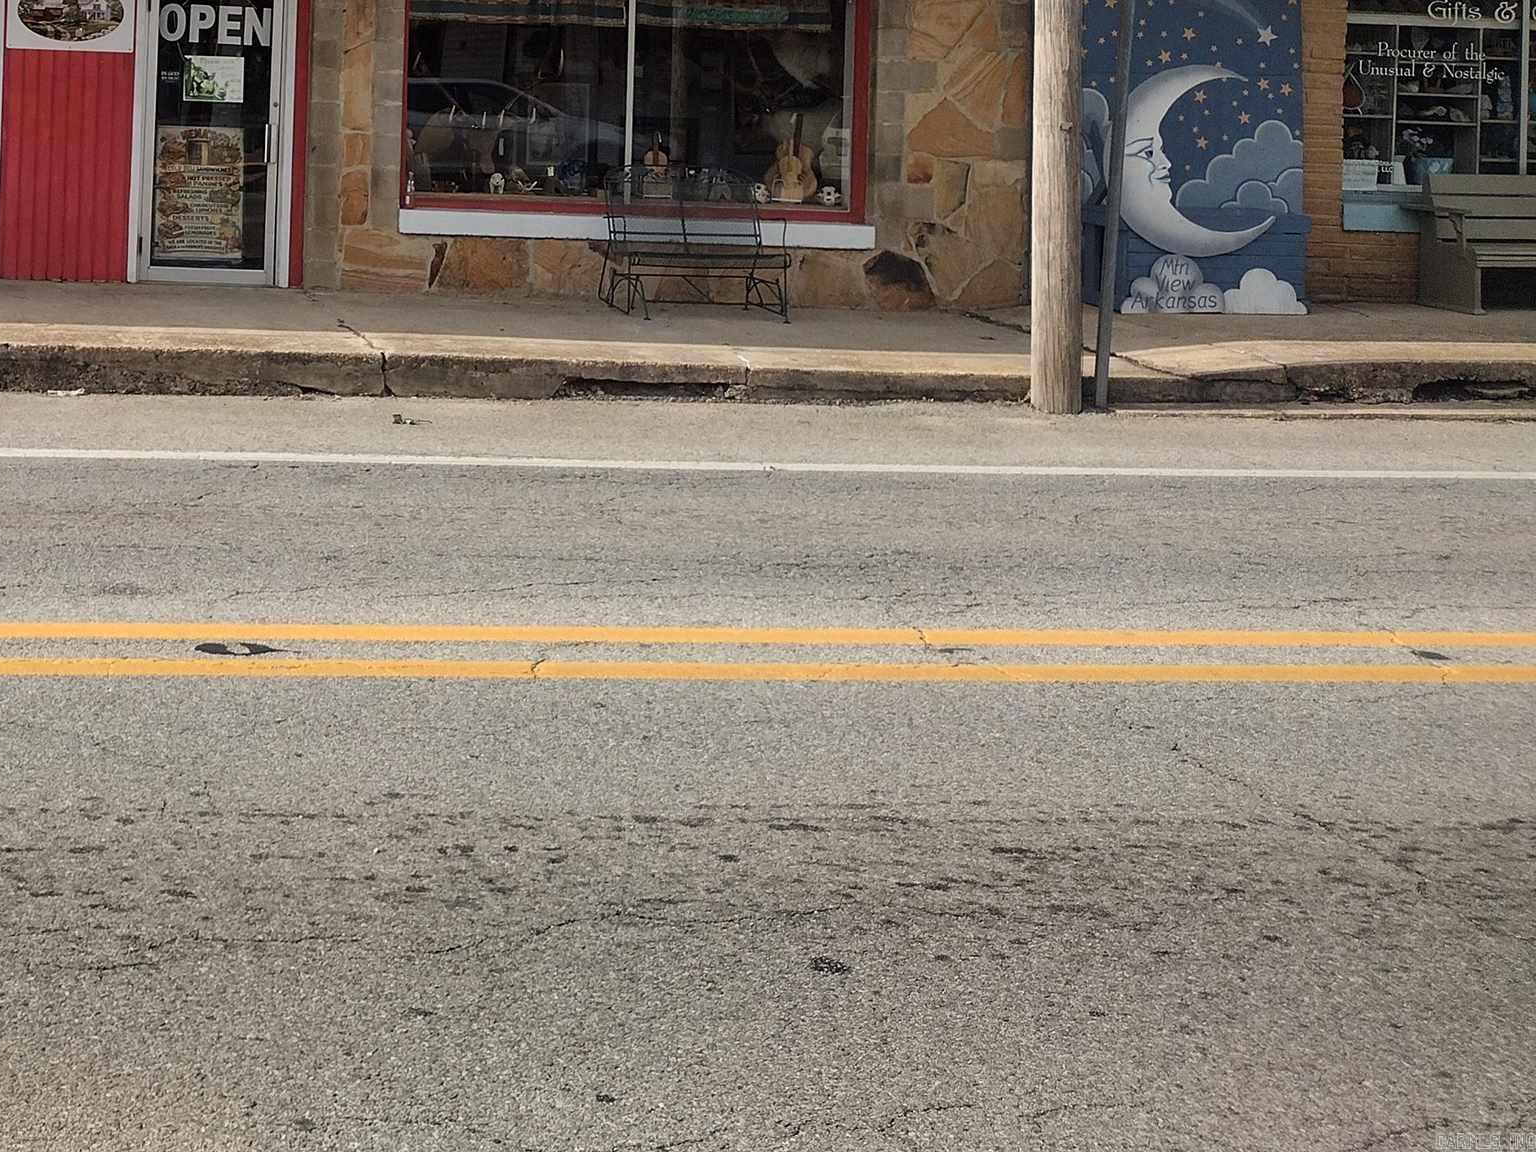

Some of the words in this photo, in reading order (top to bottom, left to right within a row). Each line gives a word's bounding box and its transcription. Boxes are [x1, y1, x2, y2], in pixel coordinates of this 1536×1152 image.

[1427, 0, 1482, 25] Gifts
[1494, 1, 1518, 24] &
[159, 3, 272, 47] OPEN
[1378, 41, 1437, 60] Procurer
[1443, 42, 1458, 61] of
[1465, 43, 1486, 61] the
[1359, 60, 1415, 77] Unusual
[1422, 63, 1436, 78] &
[1442, 62, 1505, 84] Nostalgic
[1159, 256, 1190, 276] Mtn
[1154, 273, 1195, 293] View
[1131, 291, 1217, 309] Arkansas
